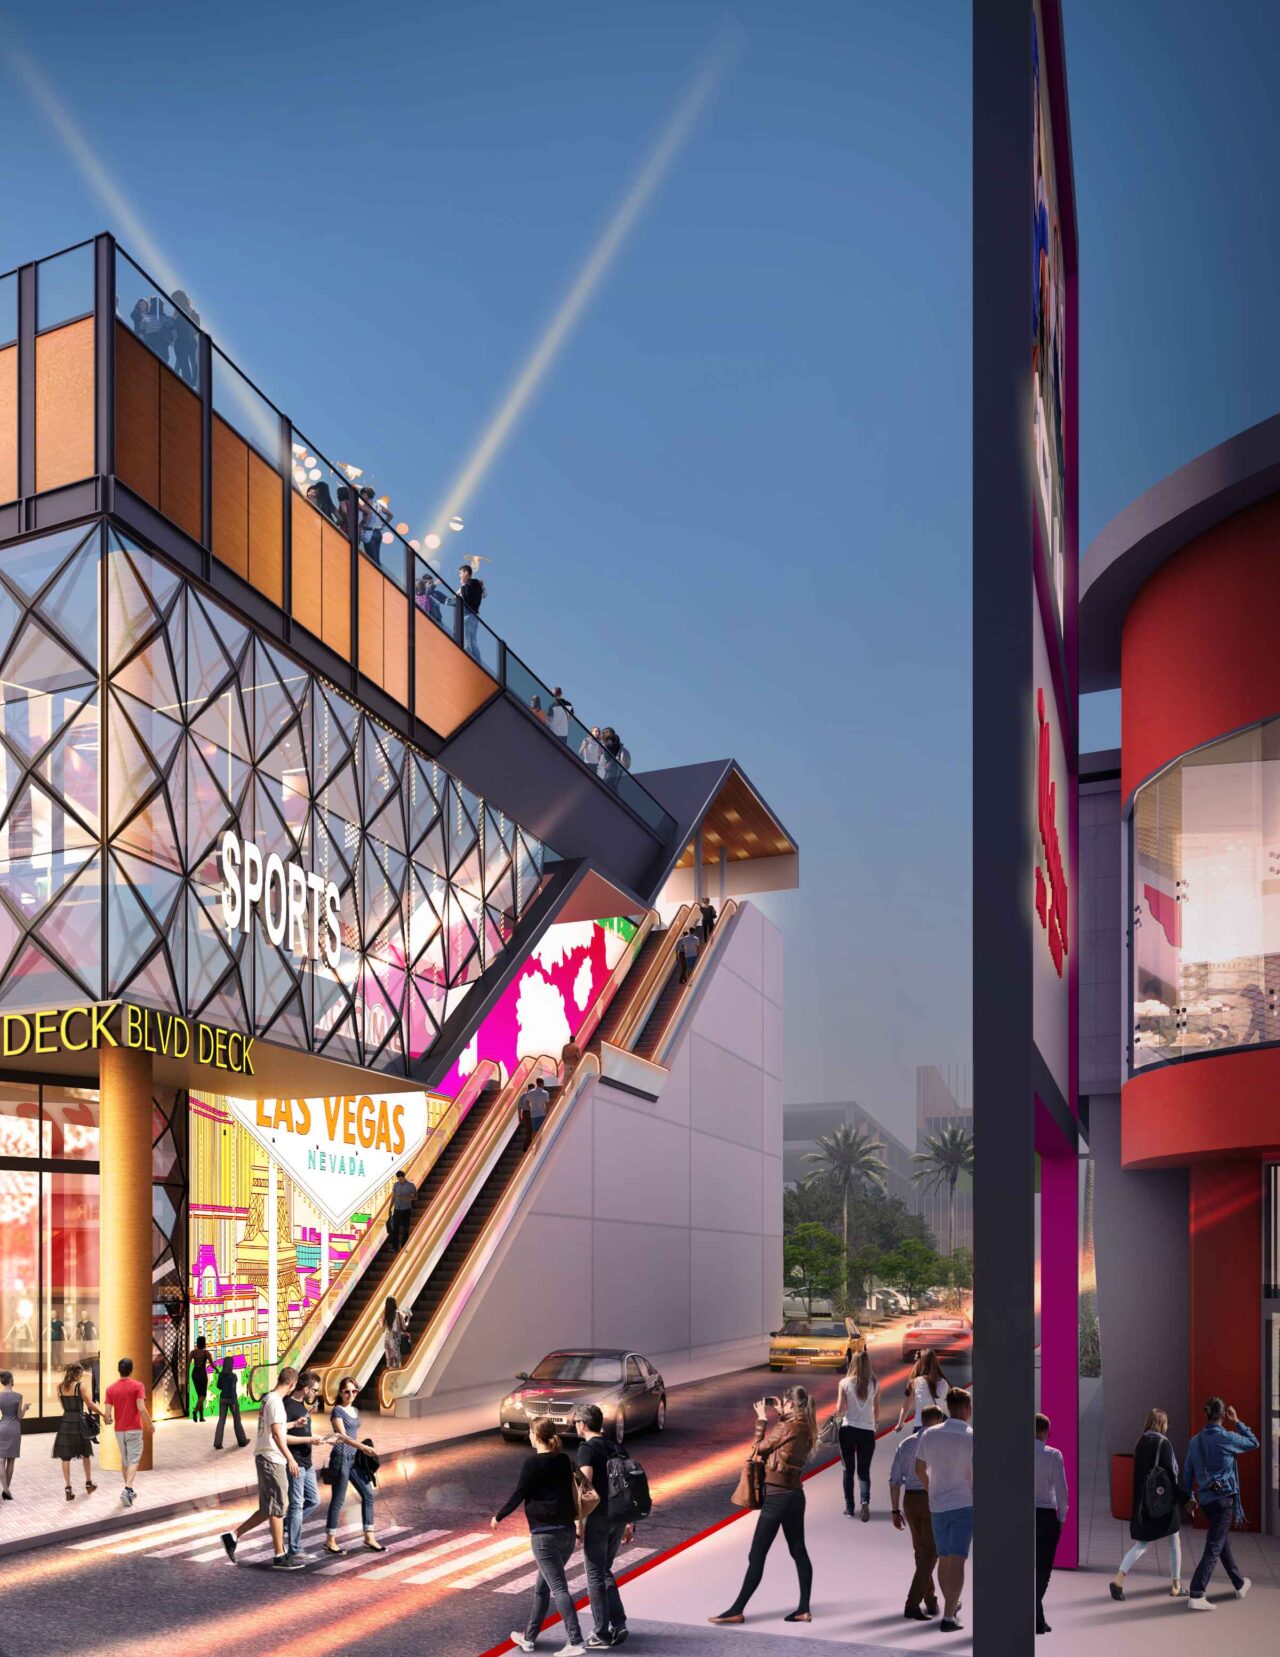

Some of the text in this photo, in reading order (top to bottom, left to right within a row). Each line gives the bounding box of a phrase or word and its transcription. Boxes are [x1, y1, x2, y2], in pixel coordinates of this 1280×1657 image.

[222, 831, 341, 969] SPORTS
[2, 1006, 120, 1057] DECK
[127, 1007, 254, 1075] BLVD DECK
[256, 1095, 405, 1155] LAS VEGAS
[307, 1150, 366, 1177] NEVADA
